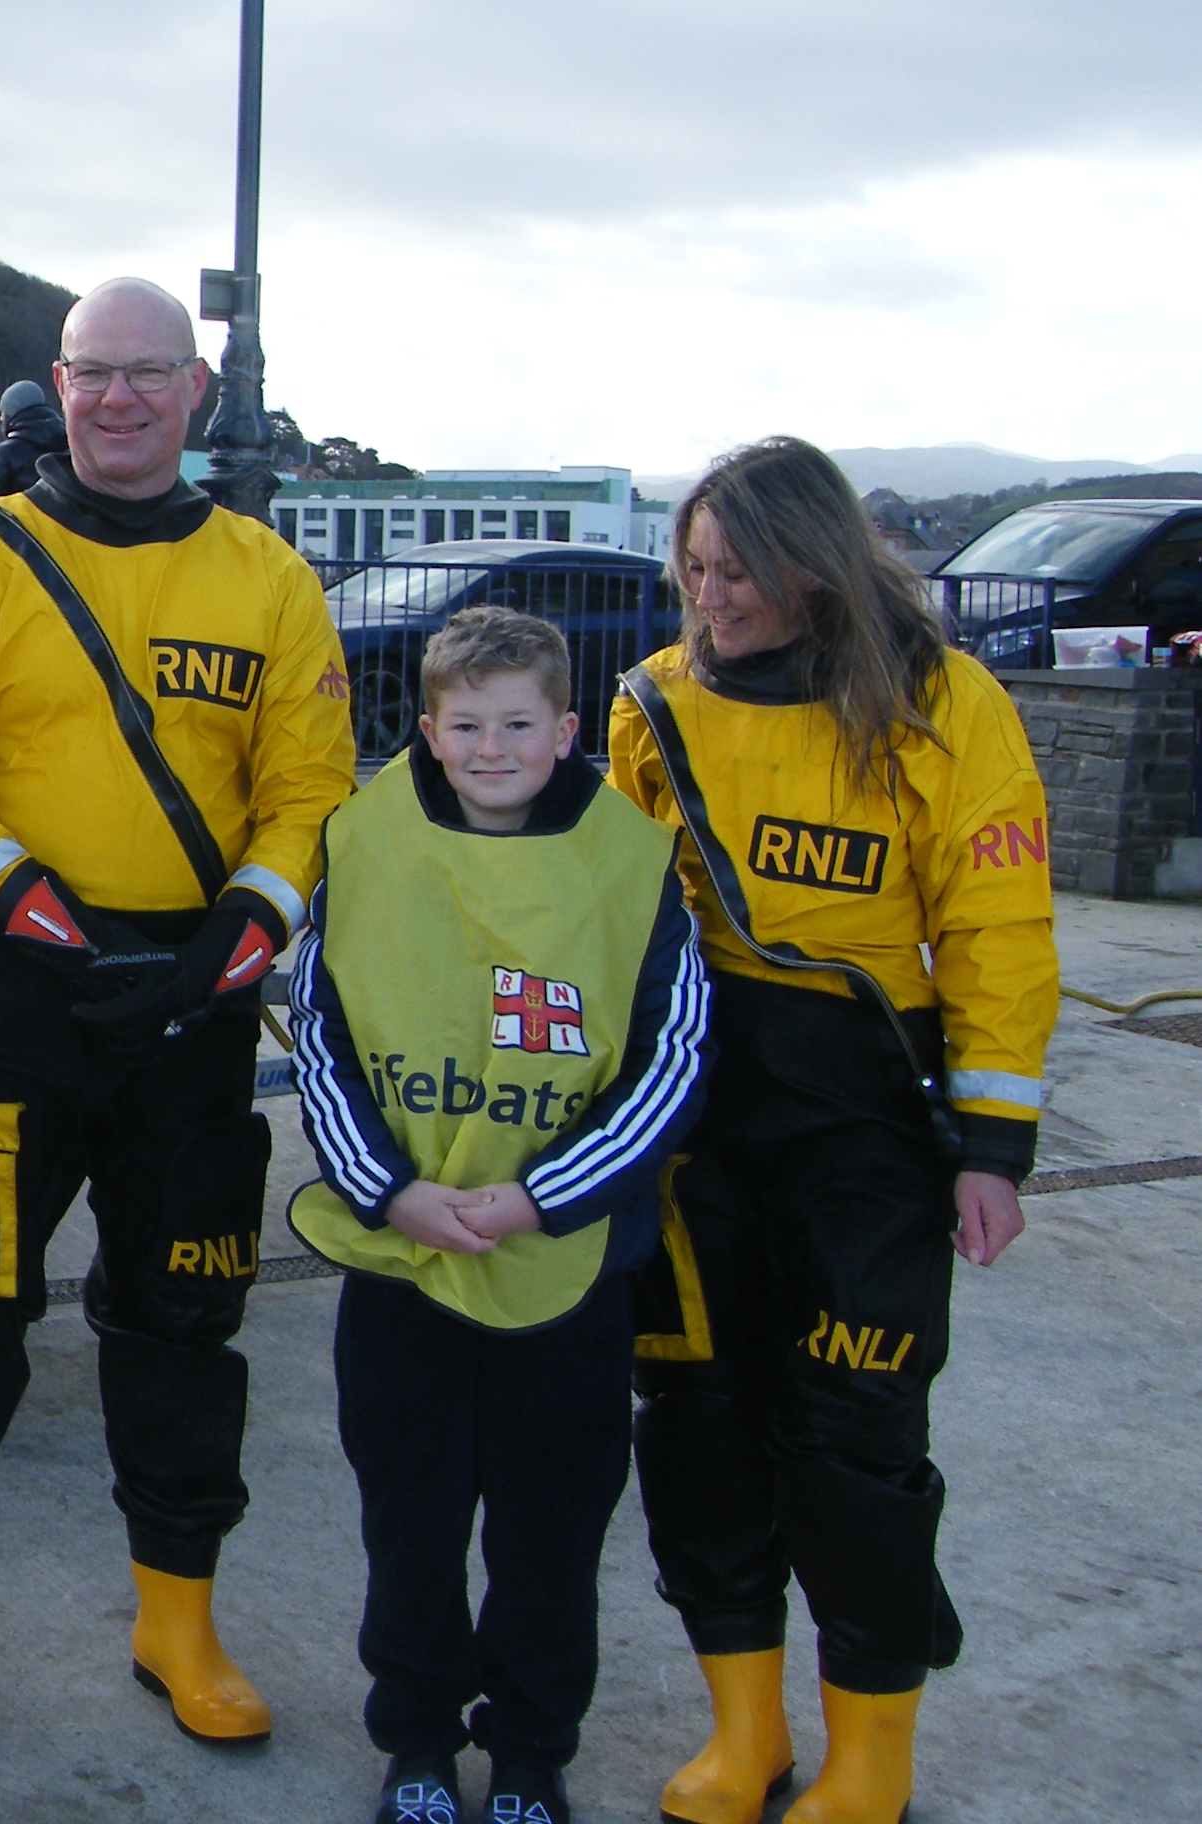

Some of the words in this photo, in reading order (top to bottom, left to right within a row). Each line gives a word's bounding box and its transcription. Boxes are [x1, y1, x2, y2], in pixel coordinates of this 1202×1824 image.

[150, 646, 257, 703] RNLI
[756, 823, 881, 887] RNLI
[970, 817, 1046, 871] RN
[168, 1231, 257, 1279] RNLI
